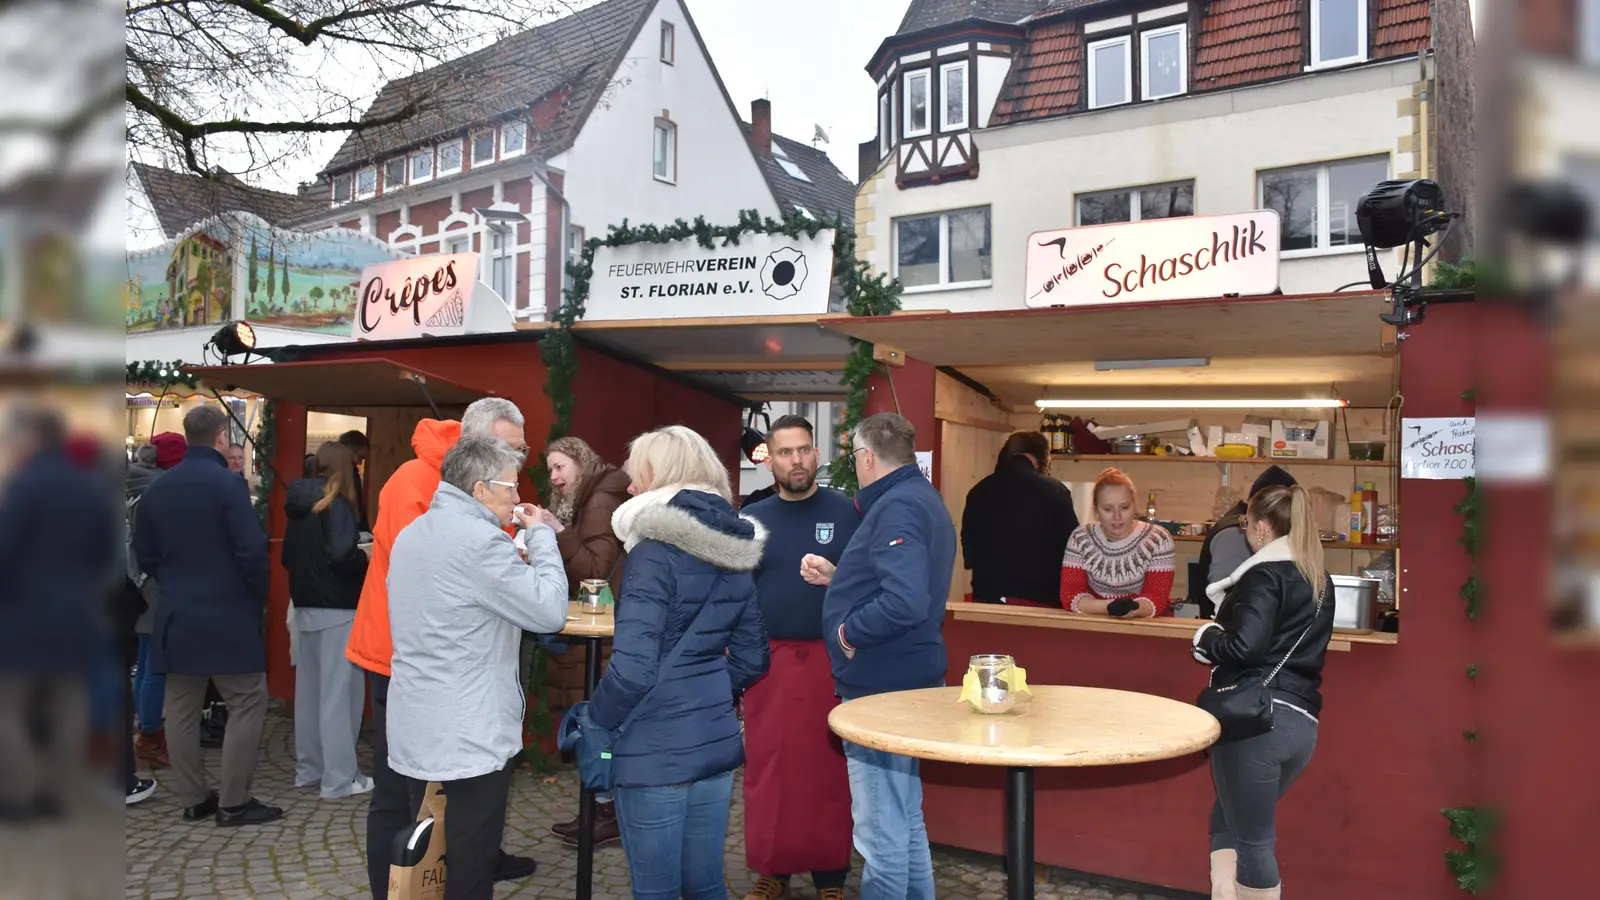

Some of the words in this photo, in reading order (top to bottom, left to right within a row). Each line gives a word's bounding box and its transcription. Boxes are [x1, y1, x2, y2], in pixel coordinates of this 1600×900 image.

[608, 256, 757, 278] FEUERWEHRVEREIN
[1102, 220, 1267, 298] Schaschlik
[359, 260, 457, 333] Crêpes
[620, 286, 644, 299] ST.
[649, 282, 718, 298] FLORIAN
[723, 280, 753, 295] e.V.
